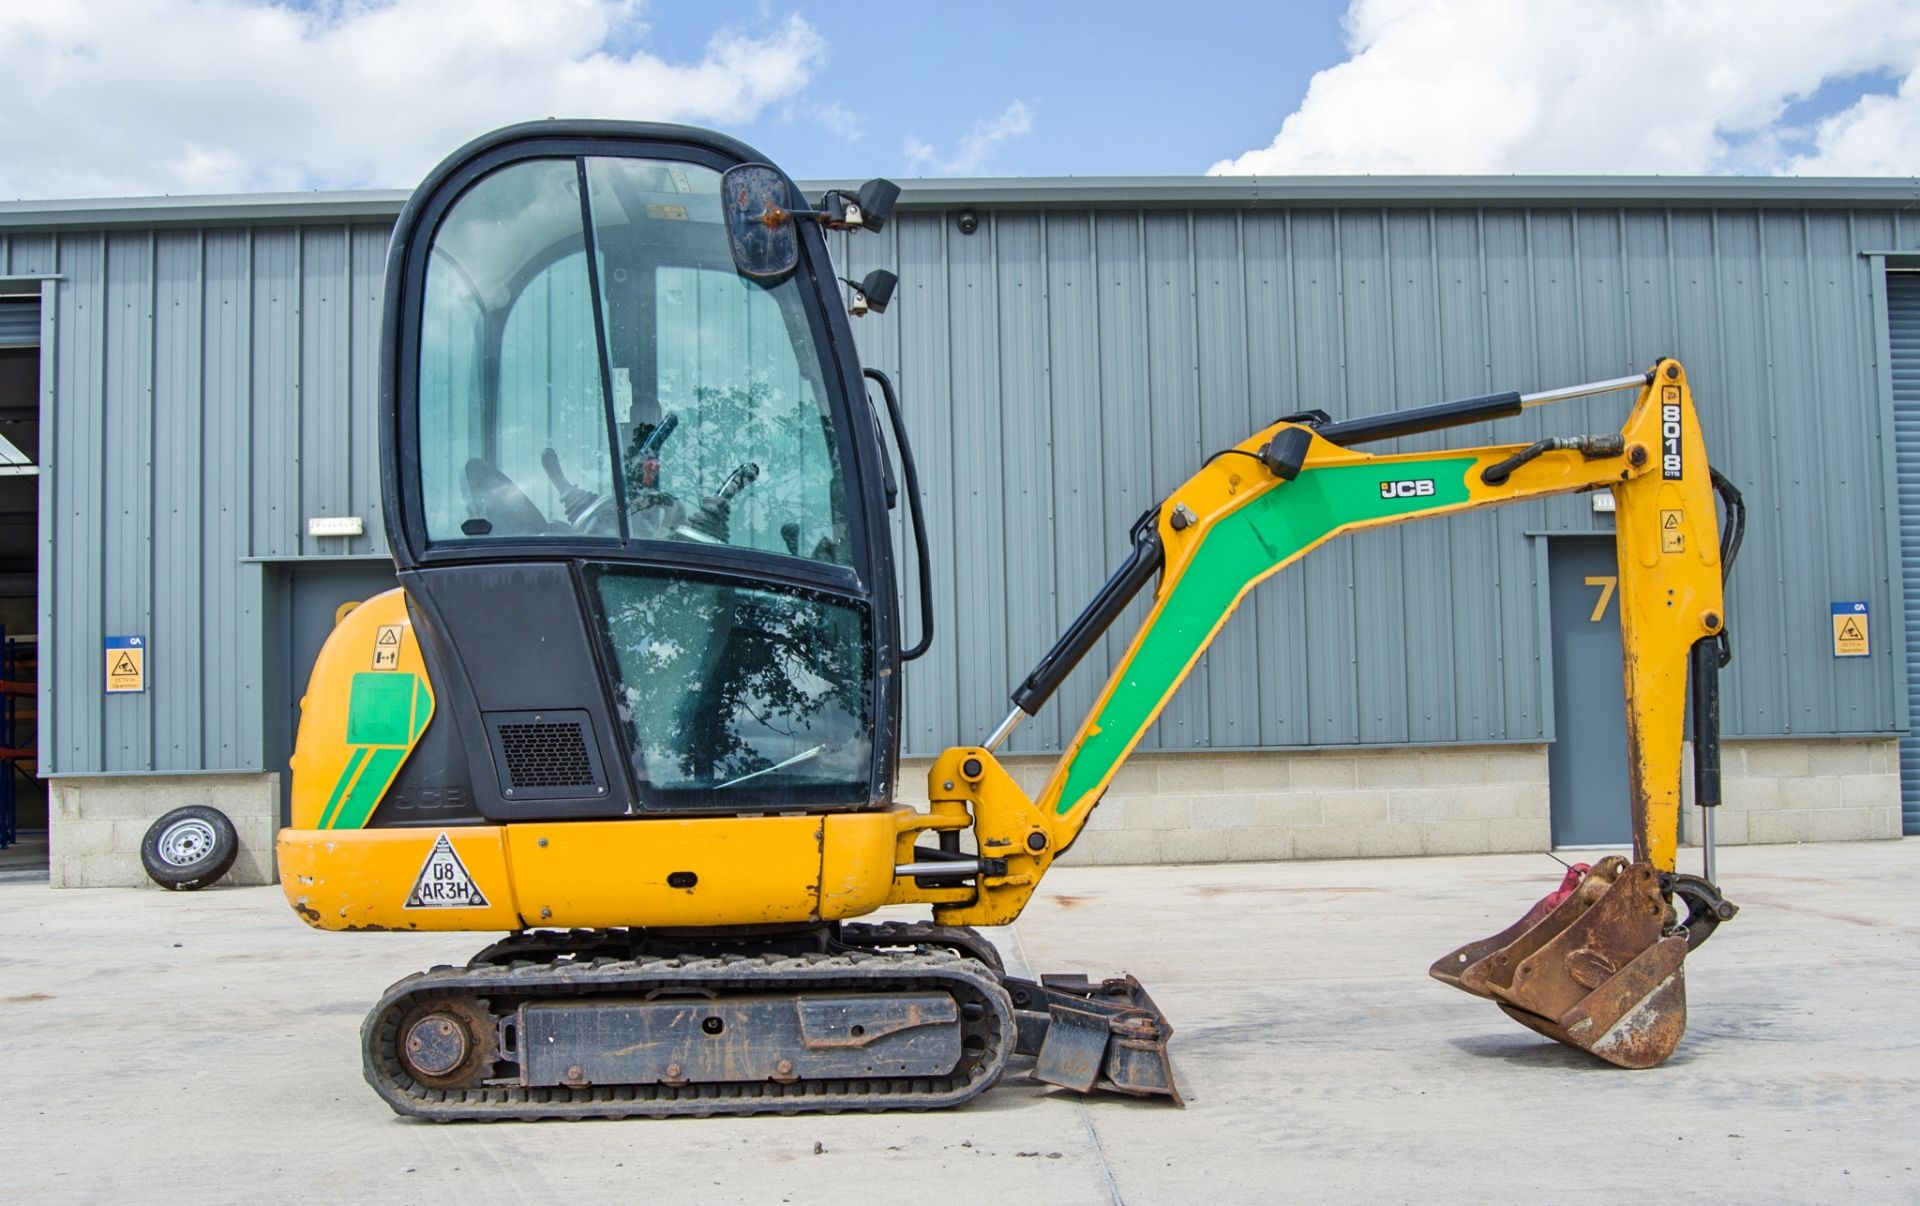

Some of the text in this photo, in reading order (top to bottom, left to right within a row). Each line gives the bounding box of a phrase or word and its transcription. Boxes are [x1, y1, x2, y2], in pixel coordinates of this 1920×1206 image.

[1663, 405, 1681, 471] 8018
[1381, 479, 1435, 498] JCB
[1585, 576, 1617, 622] 7
[394, 785, 468, 810] JCB
[423, 882, 469, 900] AR3H
